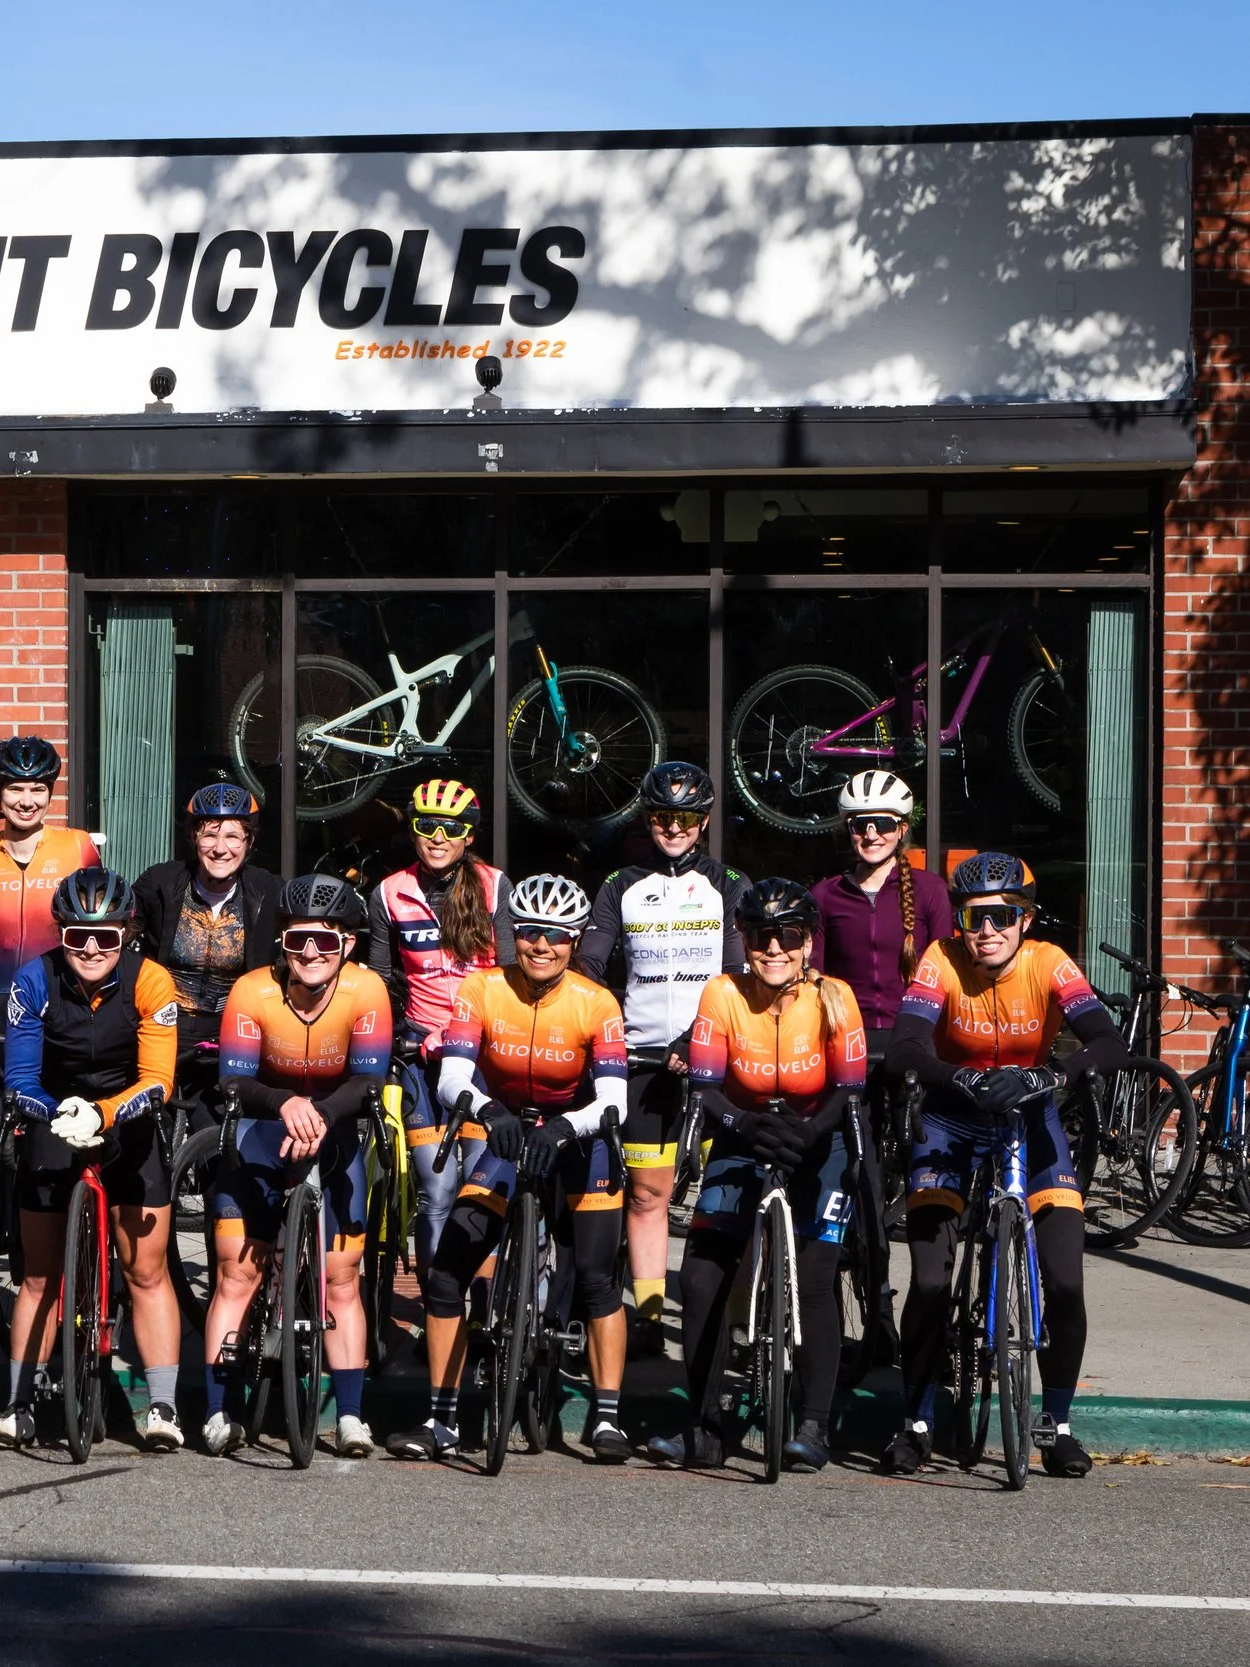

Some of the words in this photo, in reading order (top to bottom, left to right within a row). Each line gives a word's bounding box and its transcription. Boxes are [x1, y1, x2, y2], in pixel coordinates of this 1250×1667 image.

[86, 225, 586, 330] BICYCLES
[335, 339, 490, 361] Established
[502, 339, 568, 360] 1922
[623, 922, 654, 934] BODY
[400, 928, 442, 943] TR
[953, 1016, 994, 1035] ALTO
[998, 1019, 1040, 1035] VELO
[320, 1046, 339, 1056] ELIEL
[490, 1040, 530, 1057] ALTO
[534, 1046, 575, 1063] VELO
[266, 1054, 305, 1068] ALTO
[308, 1054, 347, 1067] VELO
[733, 1057, 776, 1076] ALTO
[779, 1053, 821, 1074] VELO
[596, 1179, 610, 1188] ELI
[1058, 1174, 1077, 1186] ELIEL
[1037, 1194, 1053, 1204] ALTO
